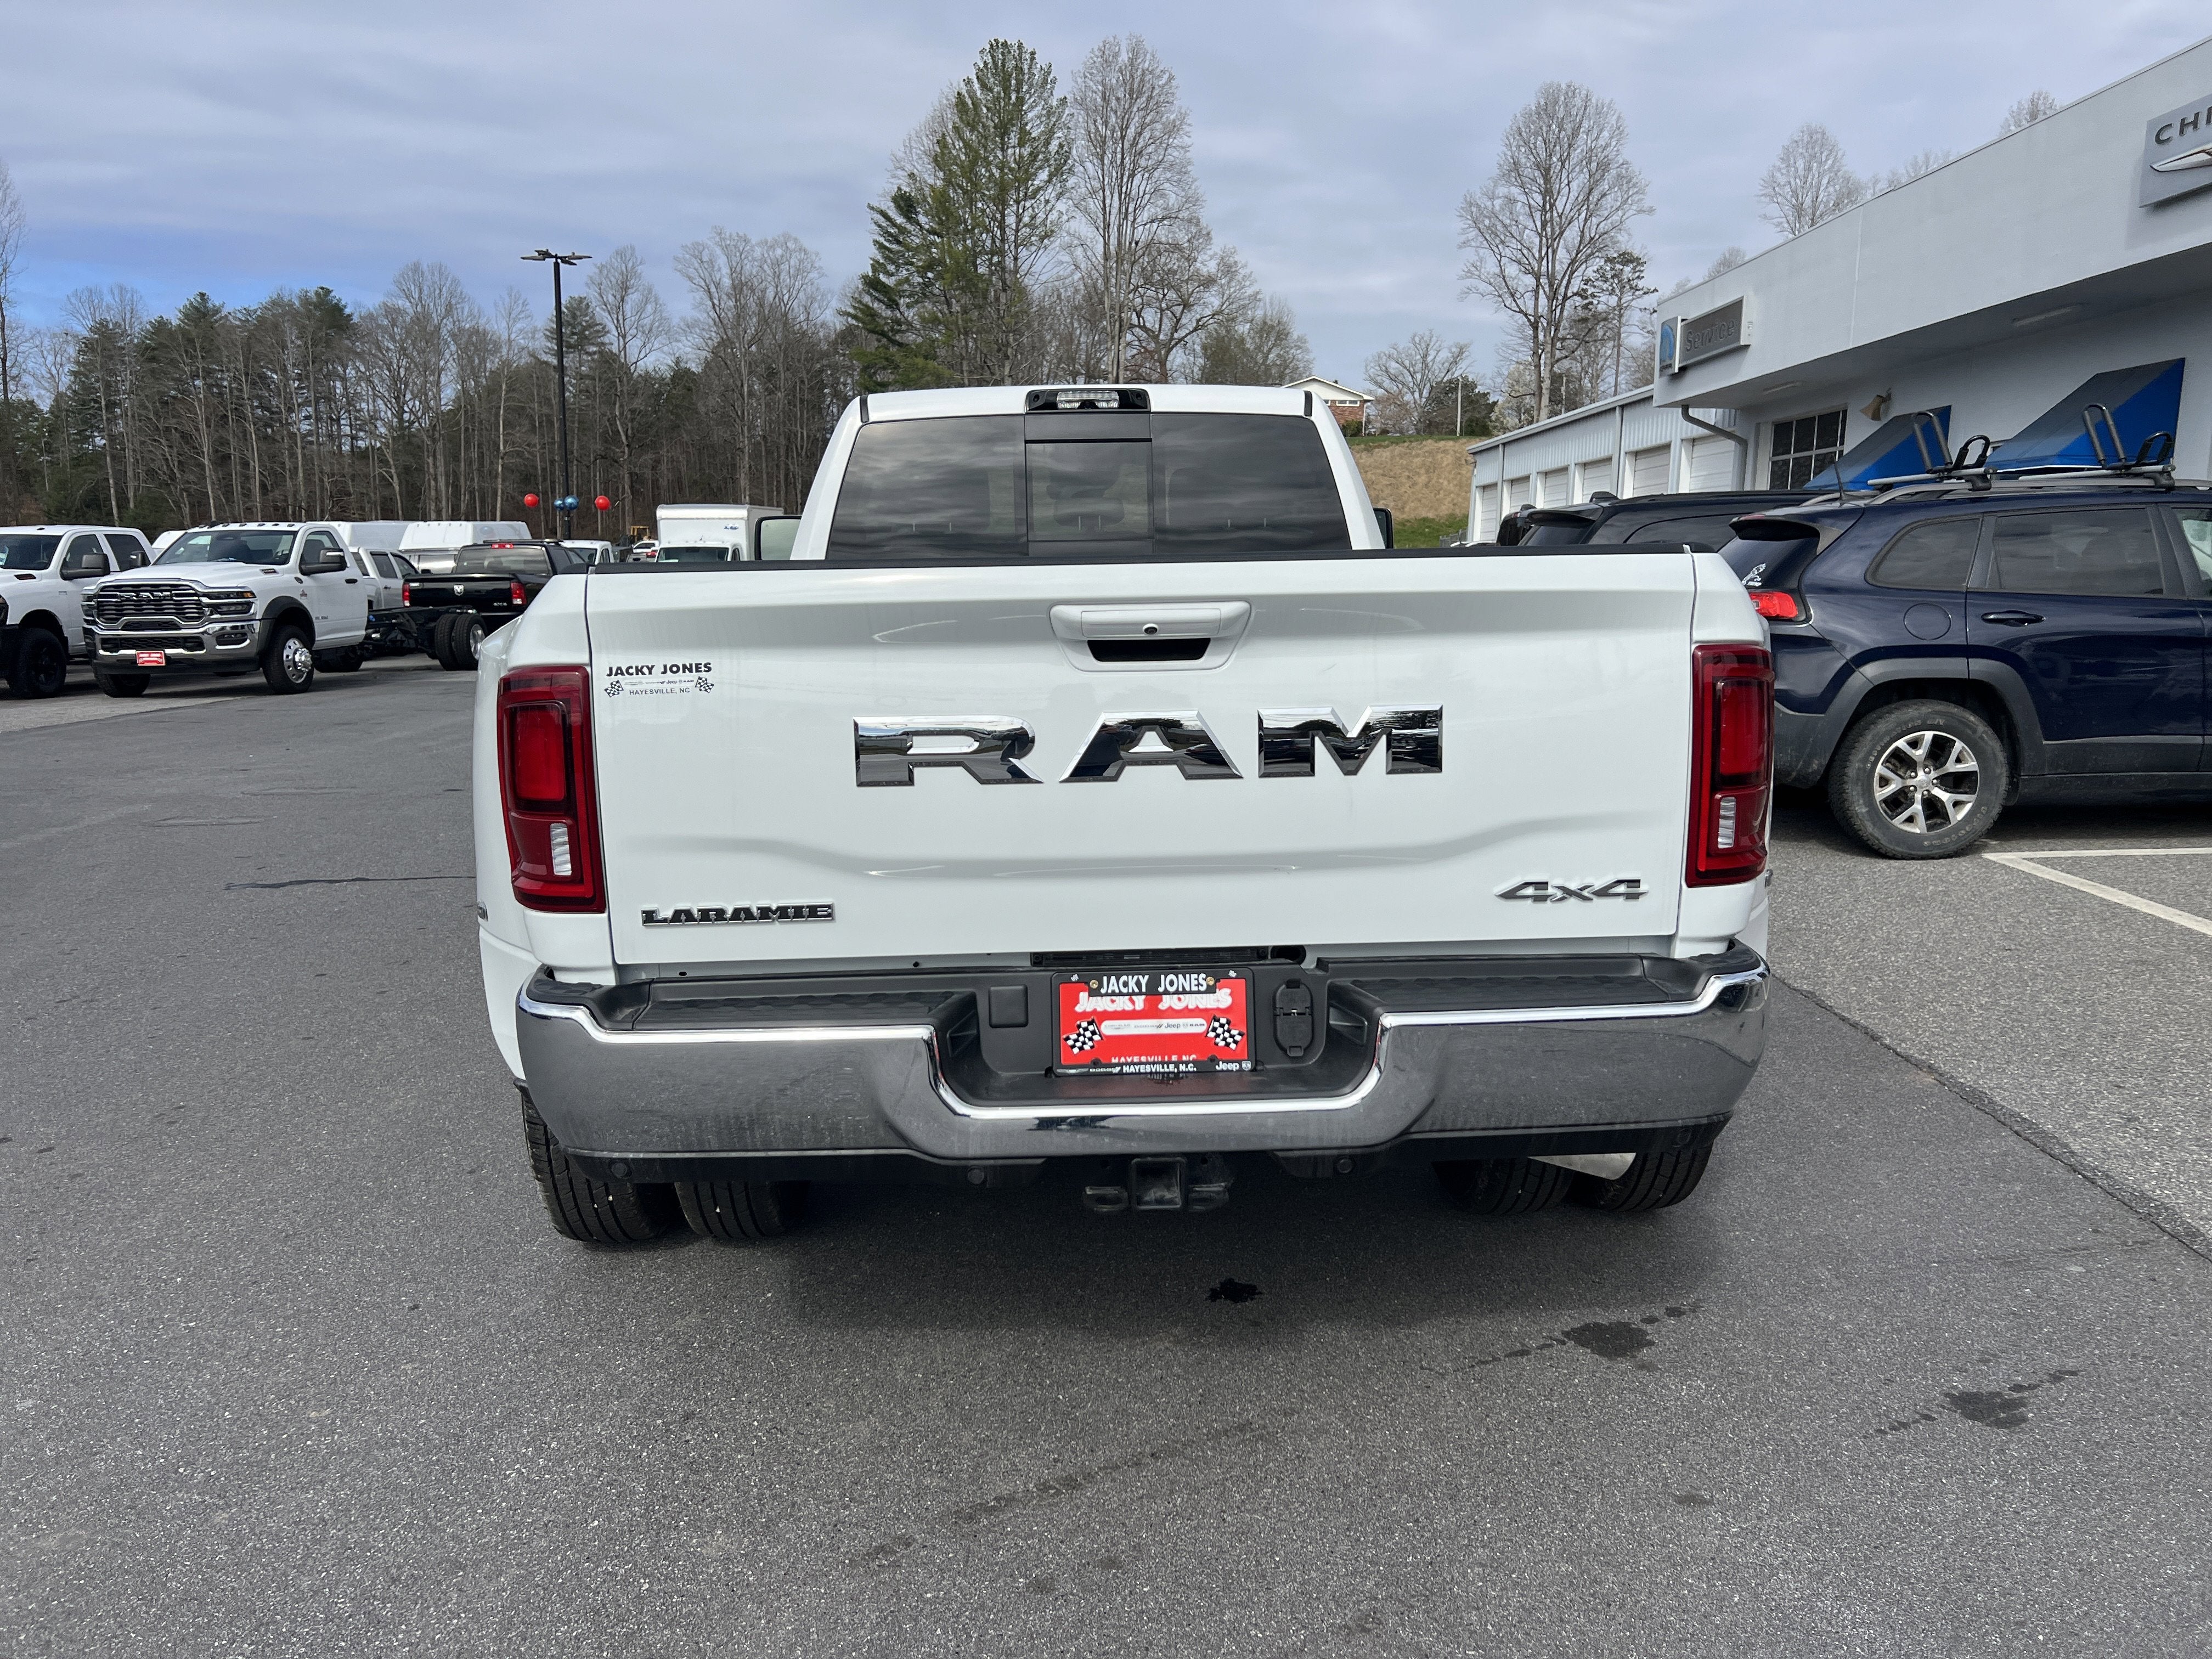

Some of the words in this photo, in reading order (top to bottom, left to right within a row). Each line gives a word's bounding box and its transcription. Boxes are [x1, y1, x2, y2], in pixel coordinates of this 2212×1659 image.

[2155, 106, 2212, 144] CH
[1686, 319, 1735, 352] Service
[606, 664, 656, 677] JACKY
[661, 662, 713, 675] JONES
[853, 703, 1443, 787] RAM
[1494, 878, 1649, 902] 4x4
[641, 901, 834, 926] LARAMIE
[1100, 974, 1149, 994] JACKY
[1158, 973, 1207, 992] JONES
[1074, 991, 1147, 1013] JACKY
[1158, 988, 1233, 1011] JONES
[1122, 1063, 1177, 1074] HAYESVILLE,
[1179, 1063, 1197, 1072] N.C.
[1215, 1060, 1240, 1071] Jeep
